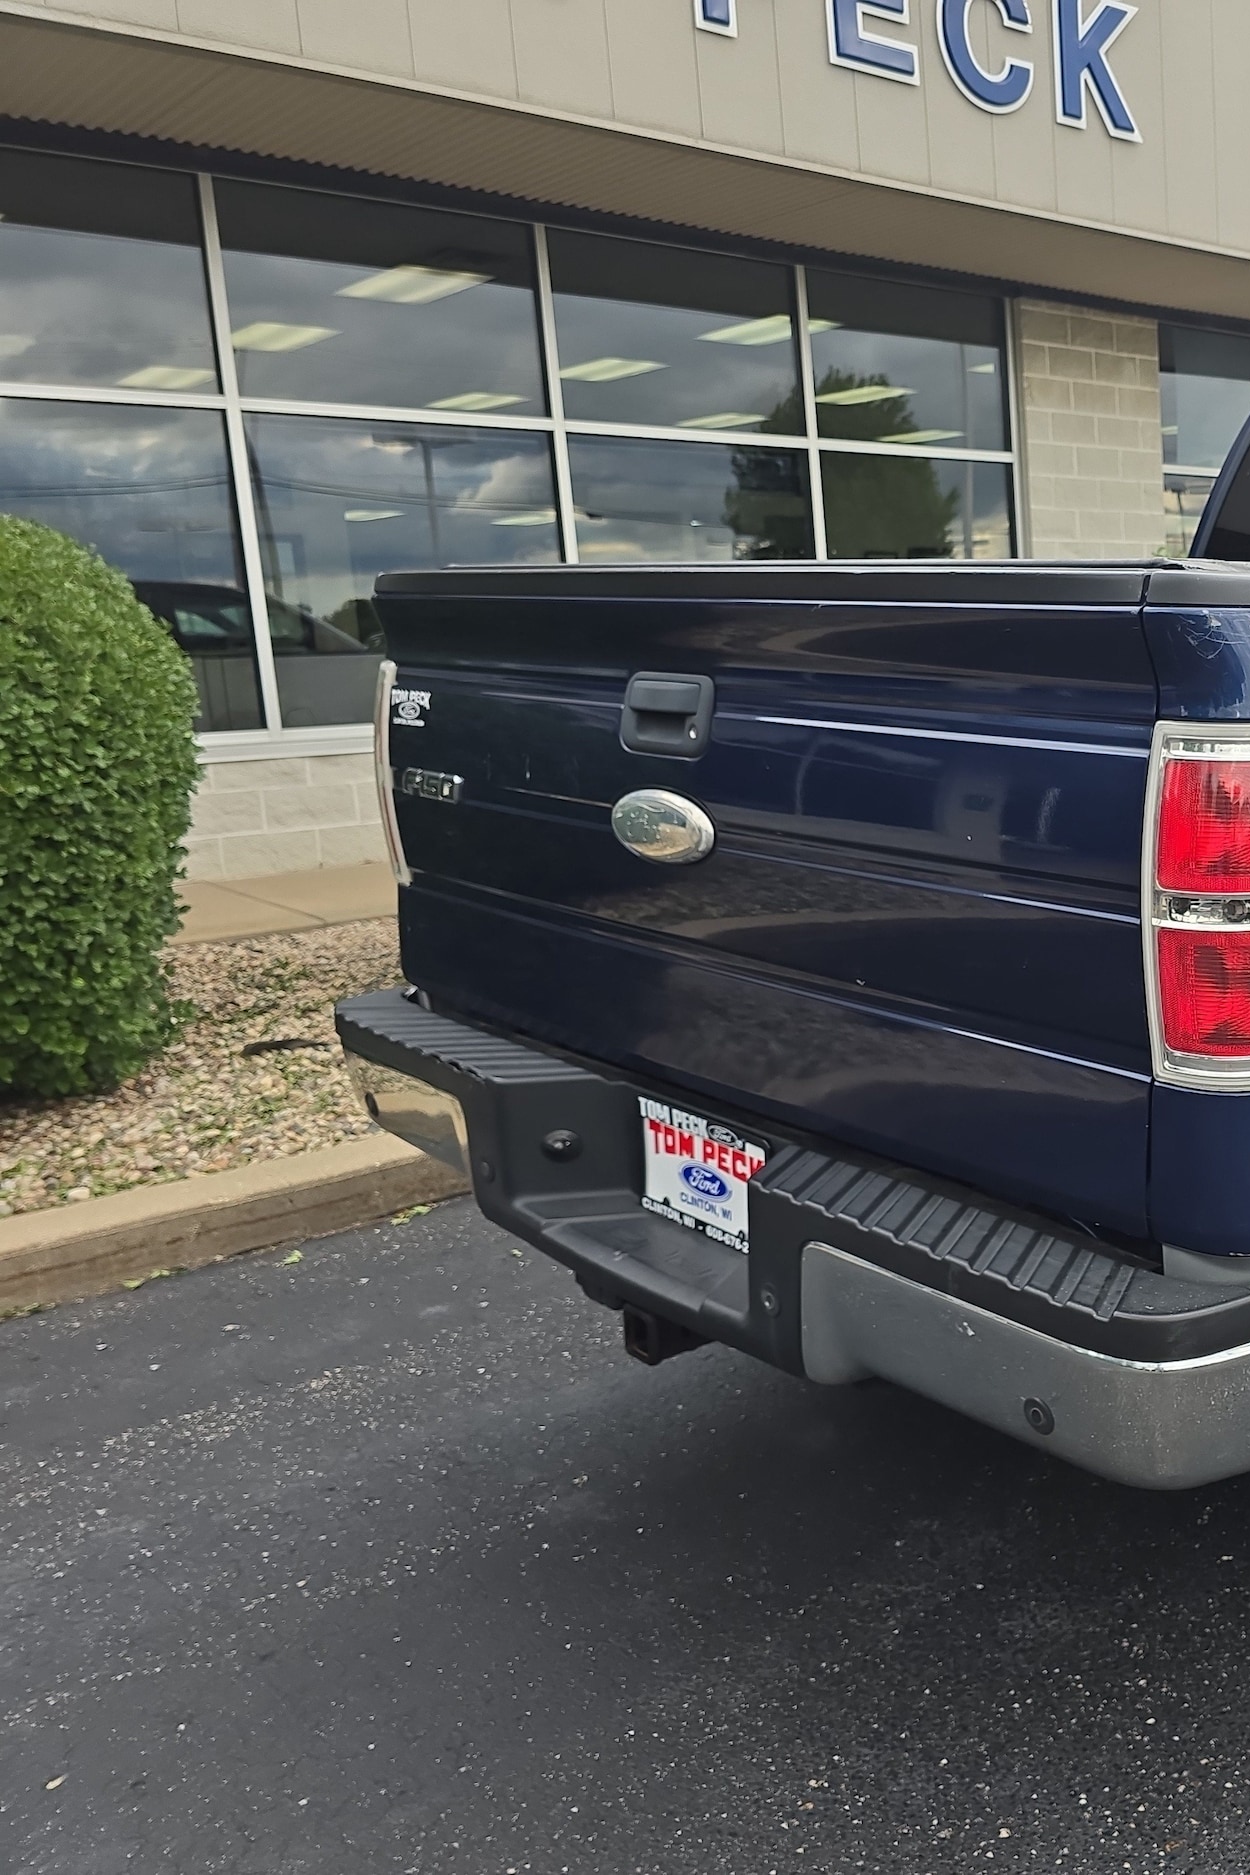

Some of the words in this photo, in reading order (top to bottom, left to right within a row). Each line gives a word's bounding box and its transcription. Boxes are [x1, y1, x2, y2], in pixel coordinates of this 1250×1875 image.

[694, 0, 1144, 144] ECK
[638, 1096, 671, 1124] TOM
[672, 1107, 709, 1139] PECK
[649, 1118, 695, 1159] TOM
[688, 1167, 721, 1195] Ford
[641, 1197, 683, 1226] CLINTON,
[683, 1215, 696, 1230] WI
[680, 1192, 719, 1217] CLINTON,
[720, 1207, 733, 1221] WI
